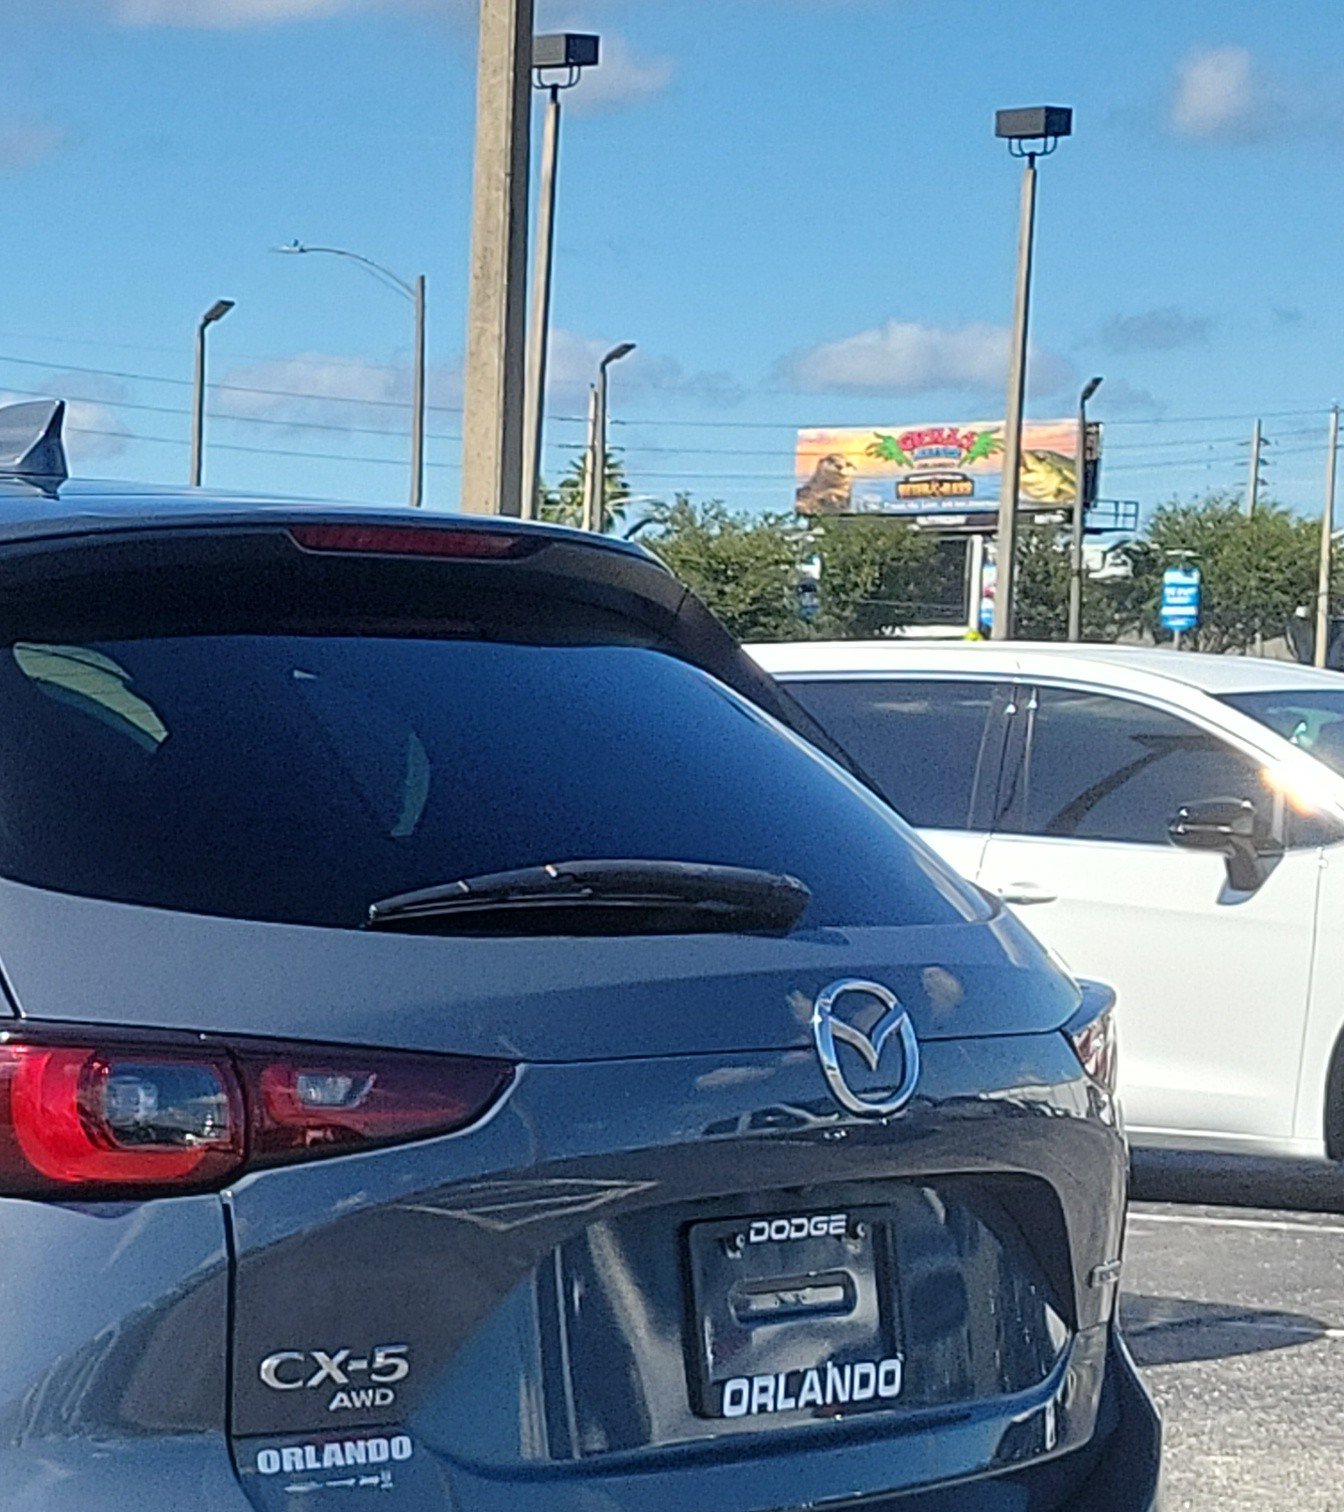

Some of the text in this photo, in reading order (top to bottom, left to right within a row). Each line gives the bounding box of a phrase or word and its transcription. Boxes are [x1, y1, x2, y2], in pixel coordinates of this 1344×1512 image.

[749, 1214, 847, 1243] DODGE
[260, 1344, 410, 1390] CX-5
[328, 1388, 395, 1412] AWD
[722, 1358, 902, 1418] ORLANDO
[257, 1435, 412, 1474] ORLANDO
